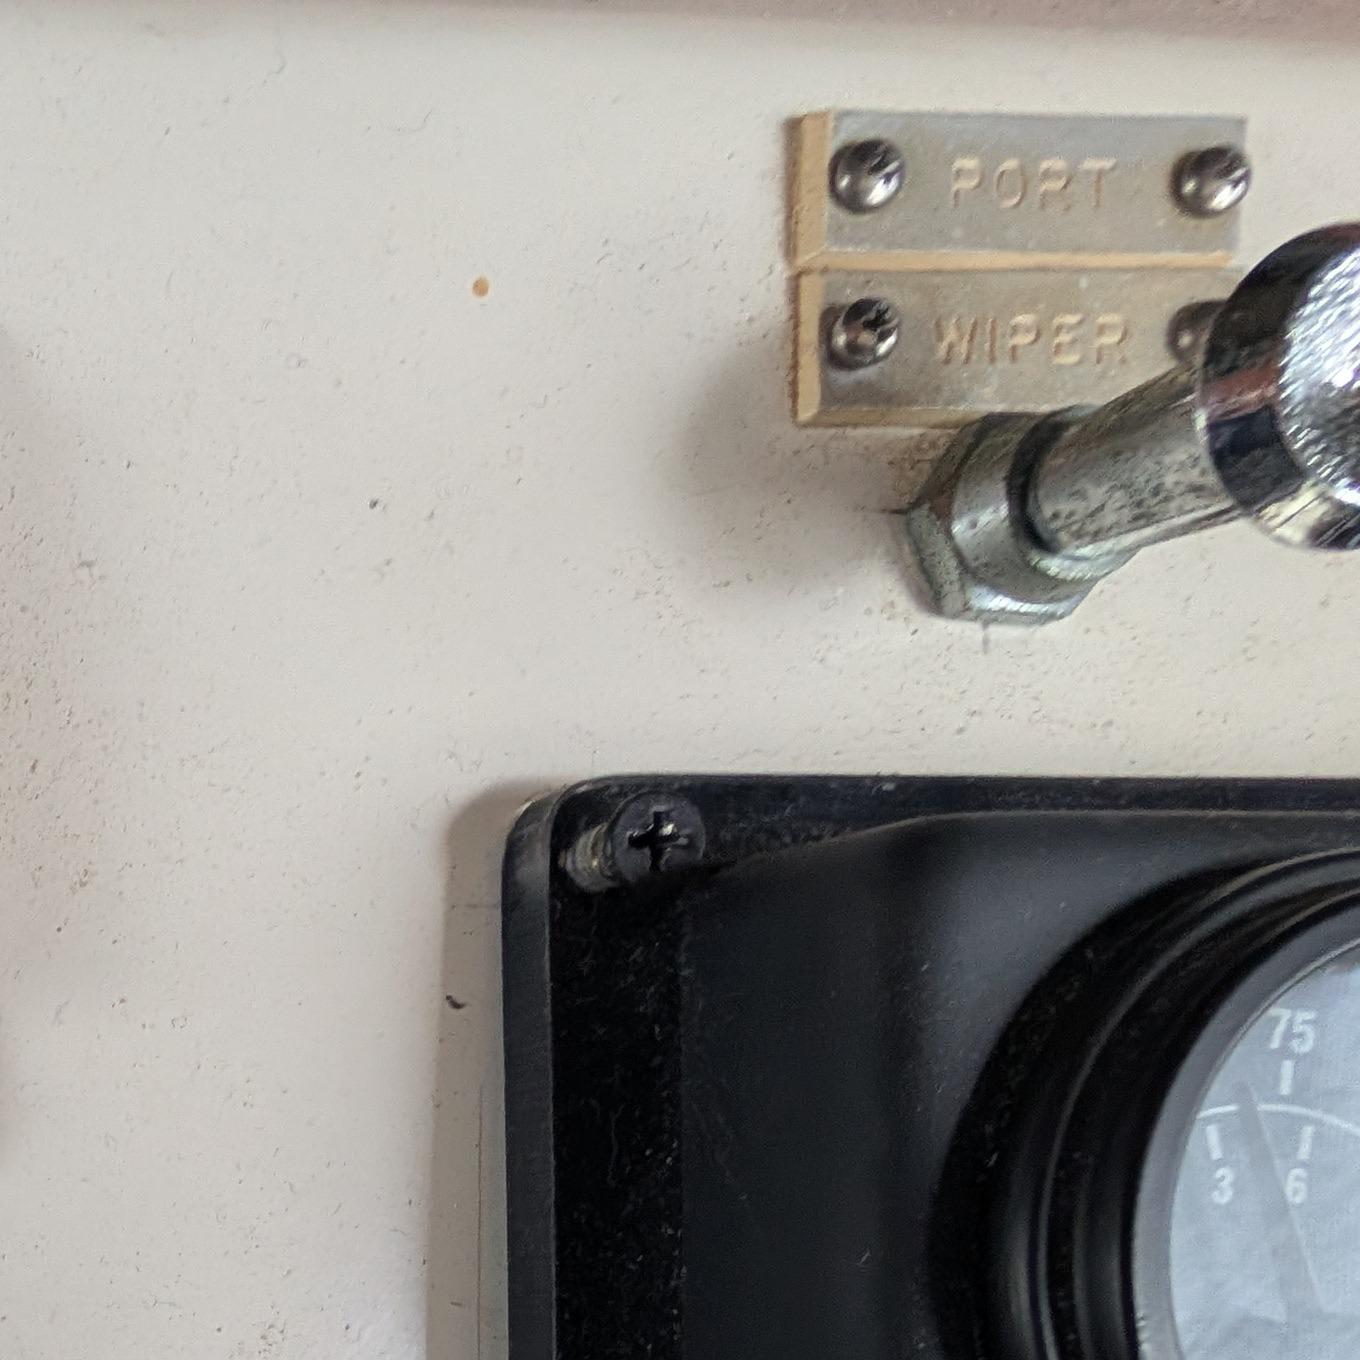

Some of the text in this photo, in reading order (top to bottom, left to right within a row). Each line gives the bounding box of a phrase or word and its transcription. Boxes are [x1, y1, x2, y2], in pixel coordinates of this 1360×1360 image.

[950, 157, 1118, 210] PORT
[932, 312, 1129, 366] WIPER
[1267, 1007, 1317, 1055] 75
[1211, 1167, 1308, 1205] 3 6
